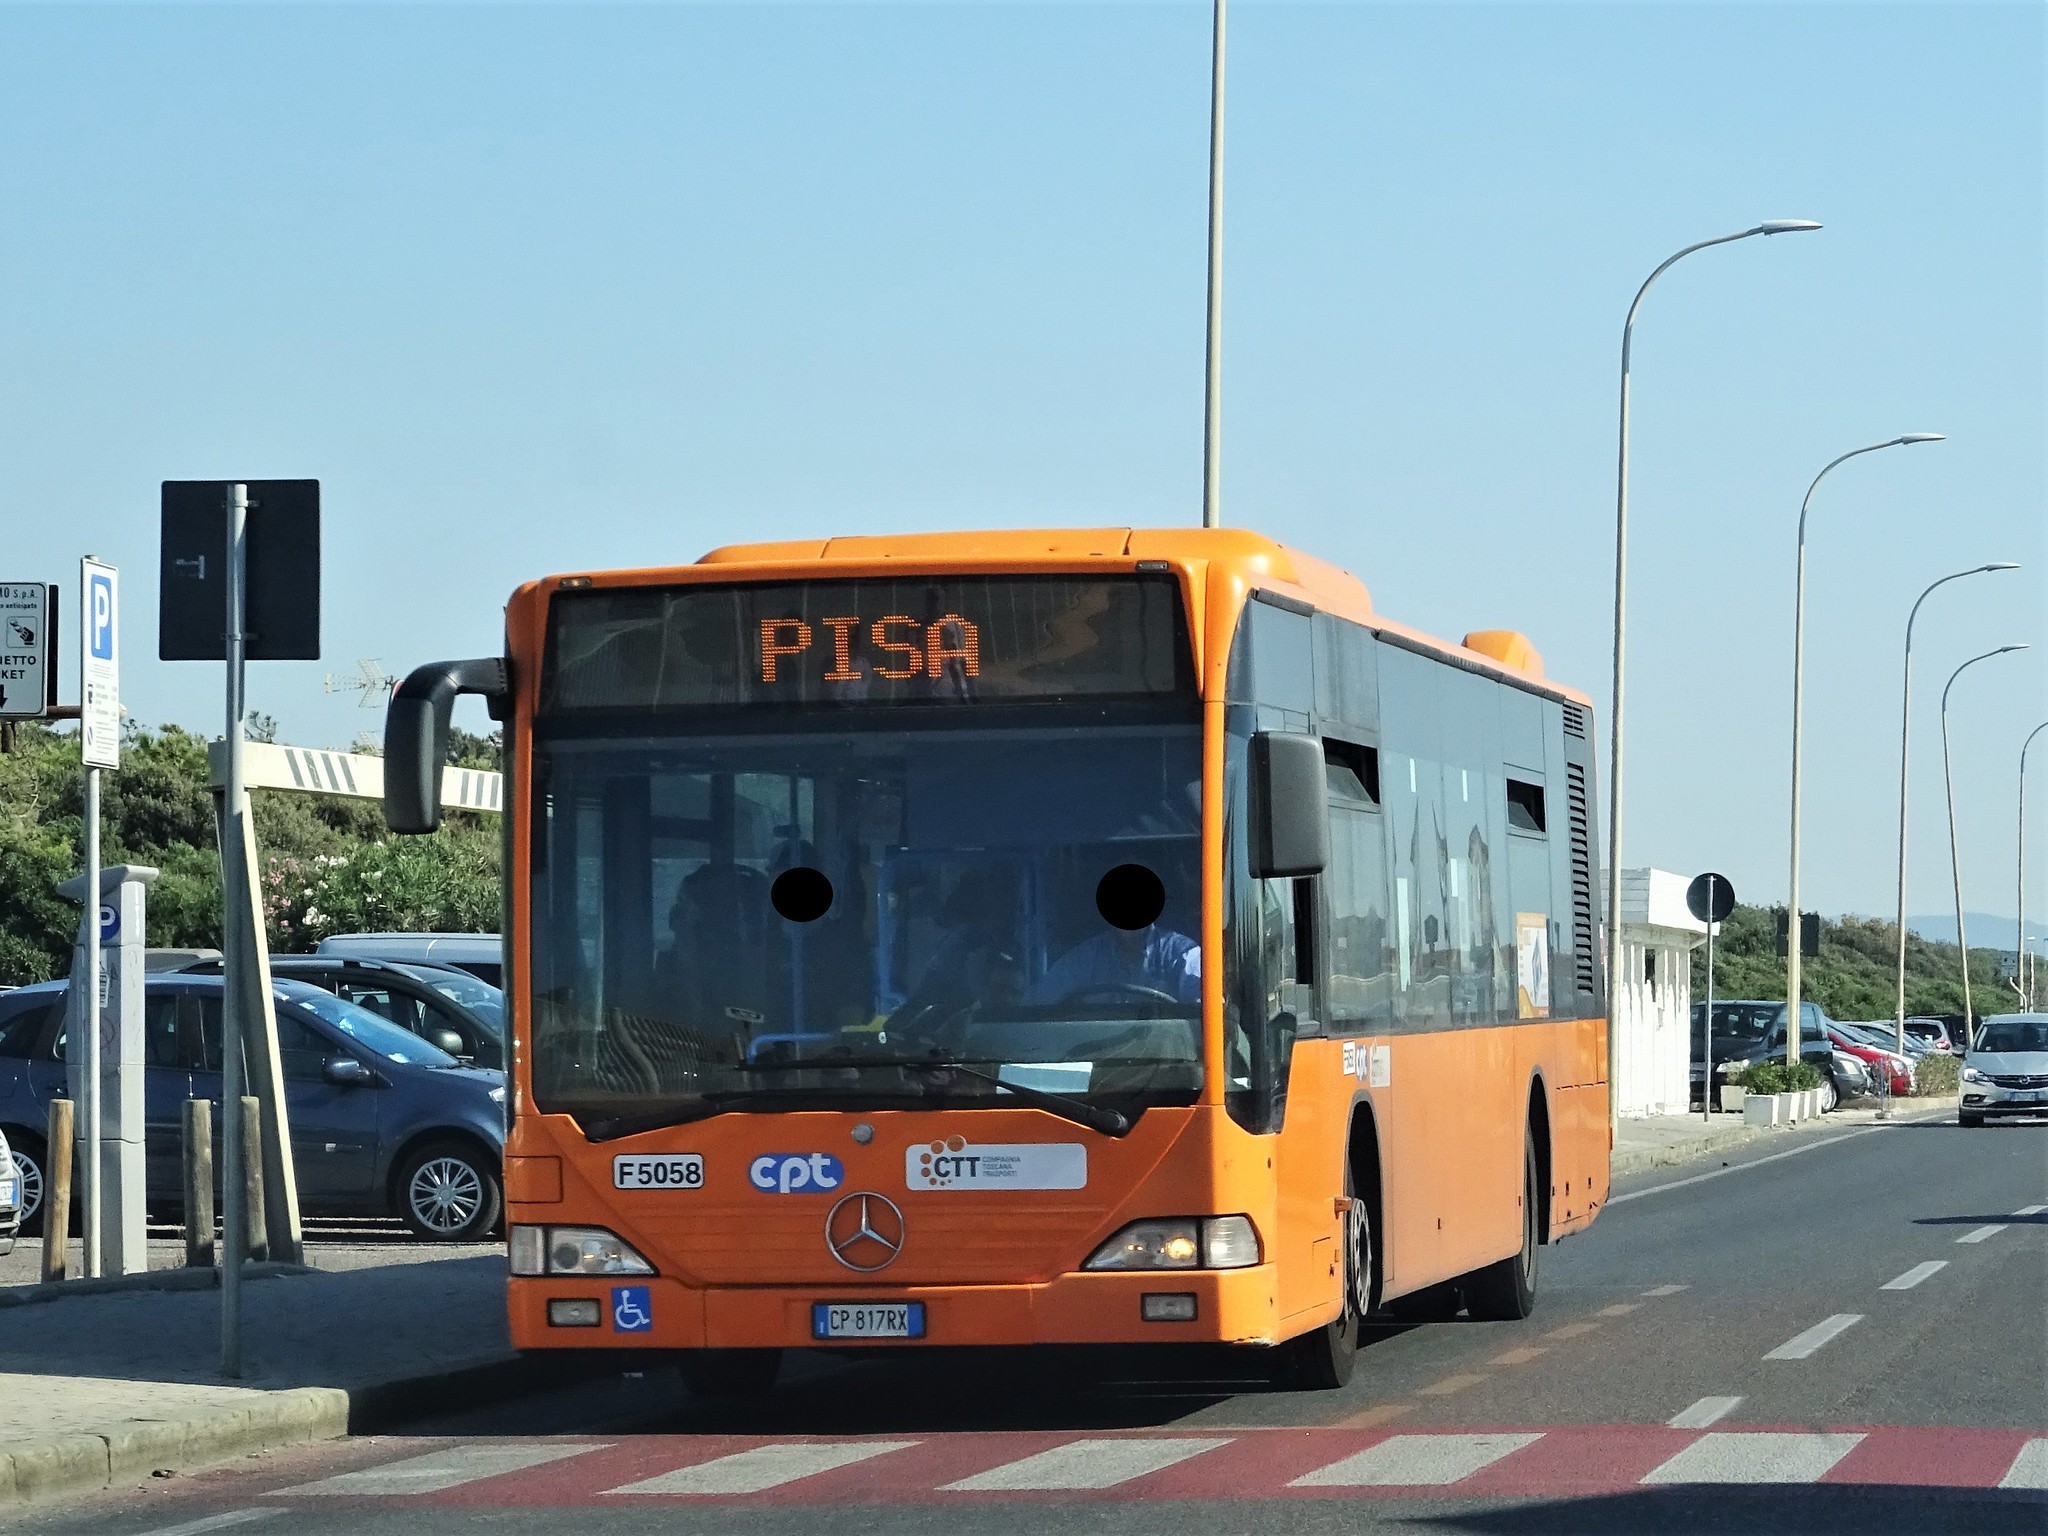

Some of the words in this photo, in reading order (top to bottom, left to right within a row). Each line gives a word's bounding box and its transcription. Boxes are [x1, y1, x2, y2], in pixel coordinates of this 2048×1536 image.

[94, 583, 110, 650] P
[760, 612, 980, 683] PISA
[750, 1152, 838, 1194] cpt
[934, 1156, 981, 1178] CTT
[829, 1310, 850, 1331] CP
[855, 1310, 908, 1331] 817RX
